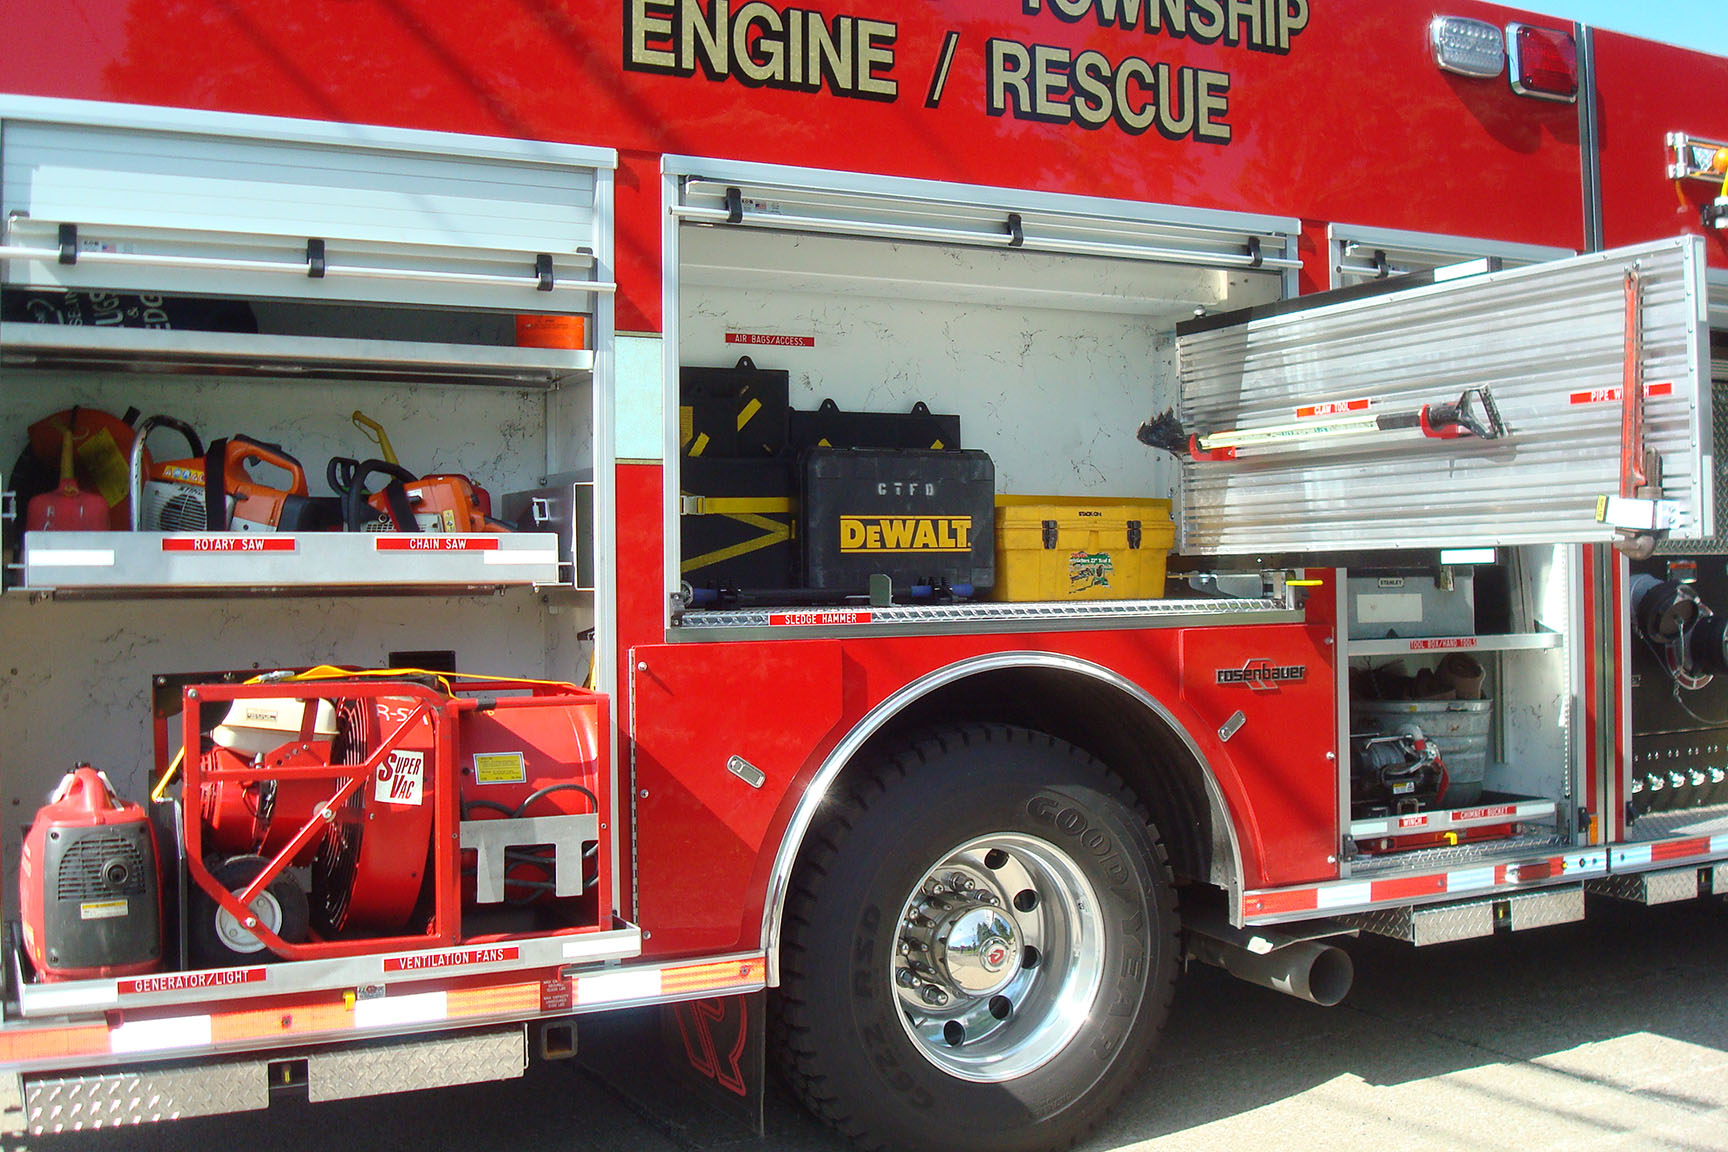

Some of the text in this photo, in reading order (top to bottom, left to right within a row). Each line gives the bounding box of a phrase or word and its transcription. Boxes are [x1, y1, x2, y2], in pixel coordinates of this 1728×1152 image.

[1022, 0, 1309, 55] SHIP
[623, 0, 898, 103] ENGINE
[986, 37, 1232, 146] RESCUE
[735, 334, 748, 343] AIR
[1591, 389, 1609, 403] PIPE
[1314, 401, 1351, 416] CLAW TOOL
[840, 519, 972, 549] DEWALT
[194, 539, 265, 550] ROTARY SAW
[409, 539, 467, 549] CHAIN SAW
[785, 613, 857, 625] SLEDGE HAMMER
[1216, 662, 1306, 683] rosenbauer
[378, 753, 421, 782] SUPER
[390, 774, 415, 799] VAC
[1487, 806, 1508, 817] BUCKET
[1402, 816, 1423, 827] WINCH
[399, 949, 504, 970] VENTILATION FANS
[135, 970, 249, 992] GENERATOR/LIGHT
